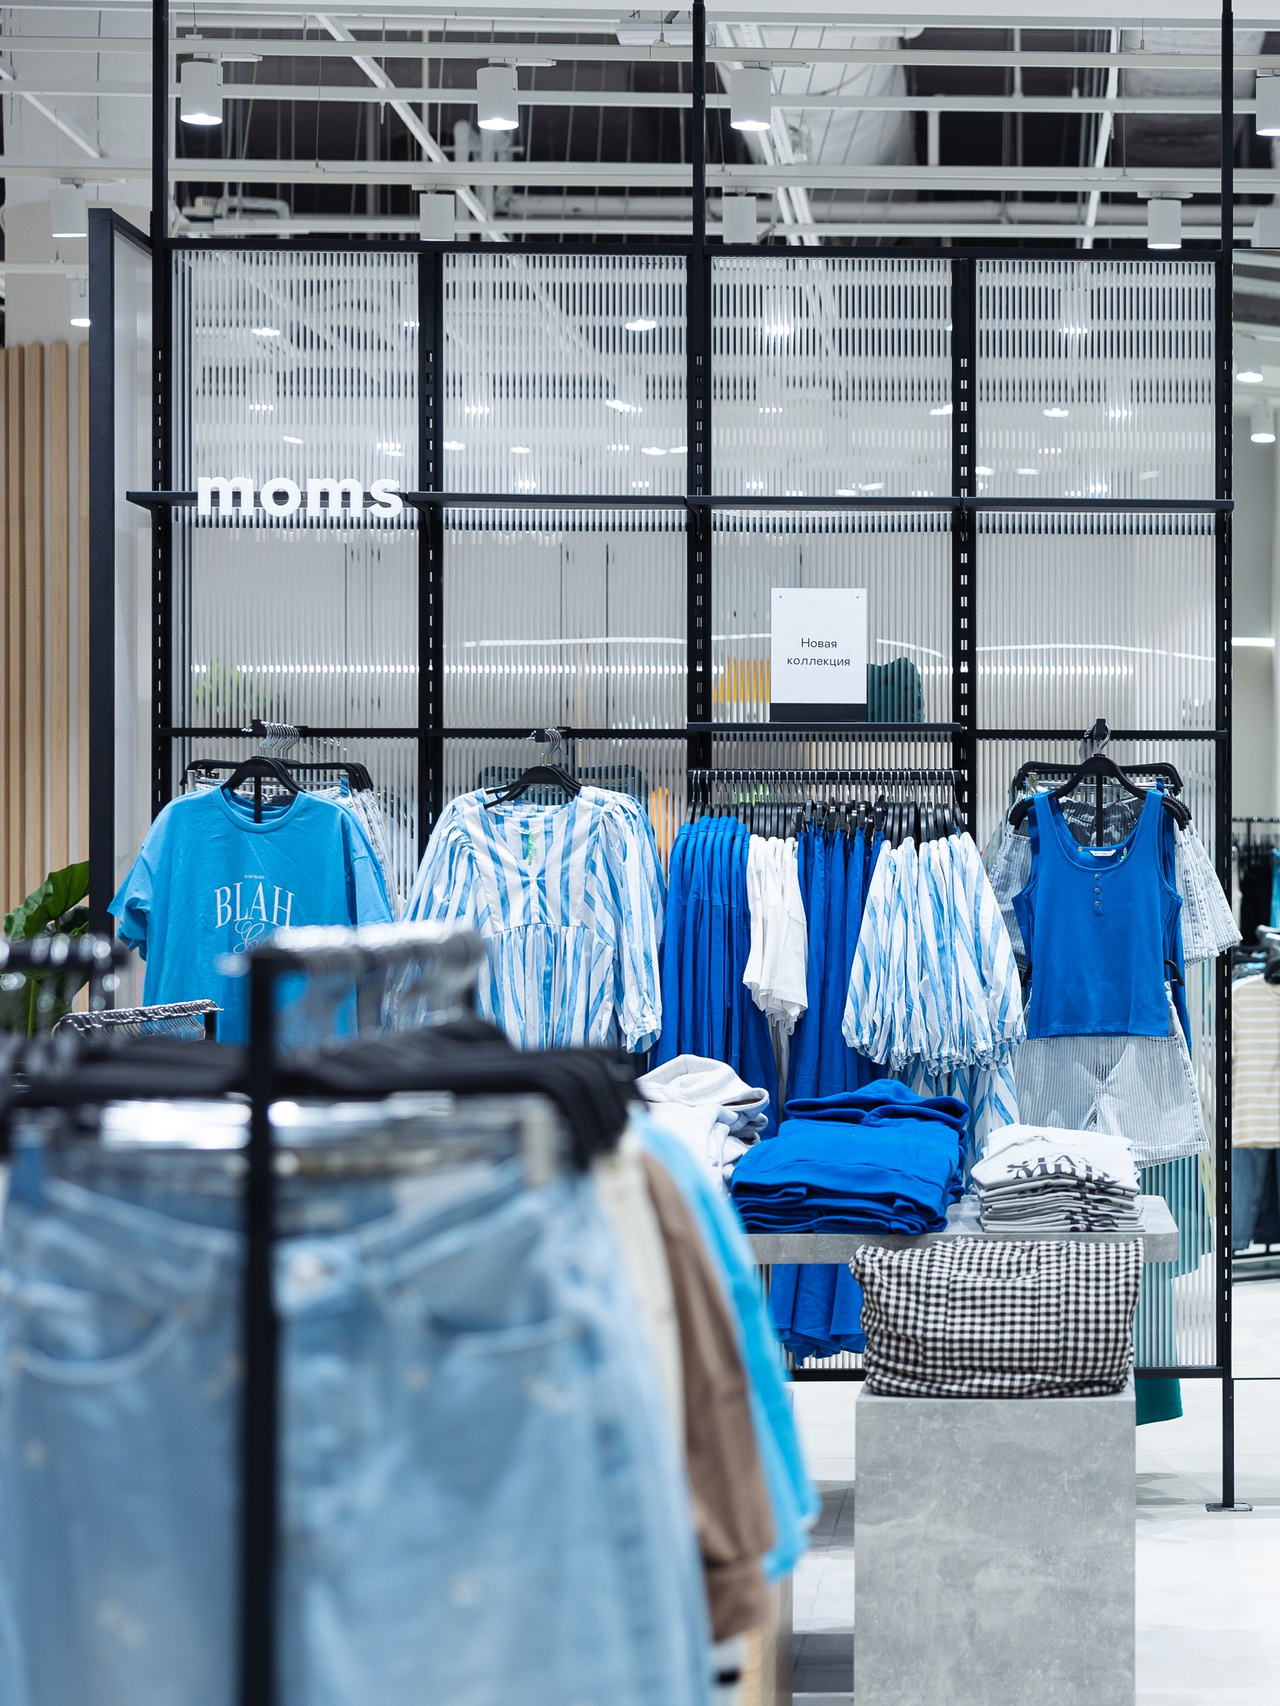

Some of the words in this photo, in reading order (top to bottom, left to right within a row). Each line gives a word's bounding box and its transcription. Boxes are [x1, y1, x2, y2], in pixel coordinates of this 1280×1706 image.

[197, 477, 403, 518] moms
[801, 637, 837, 649] Новая
[787, 657, 851, 667] коллекция
[214, 882, 295, 930] BLAH
